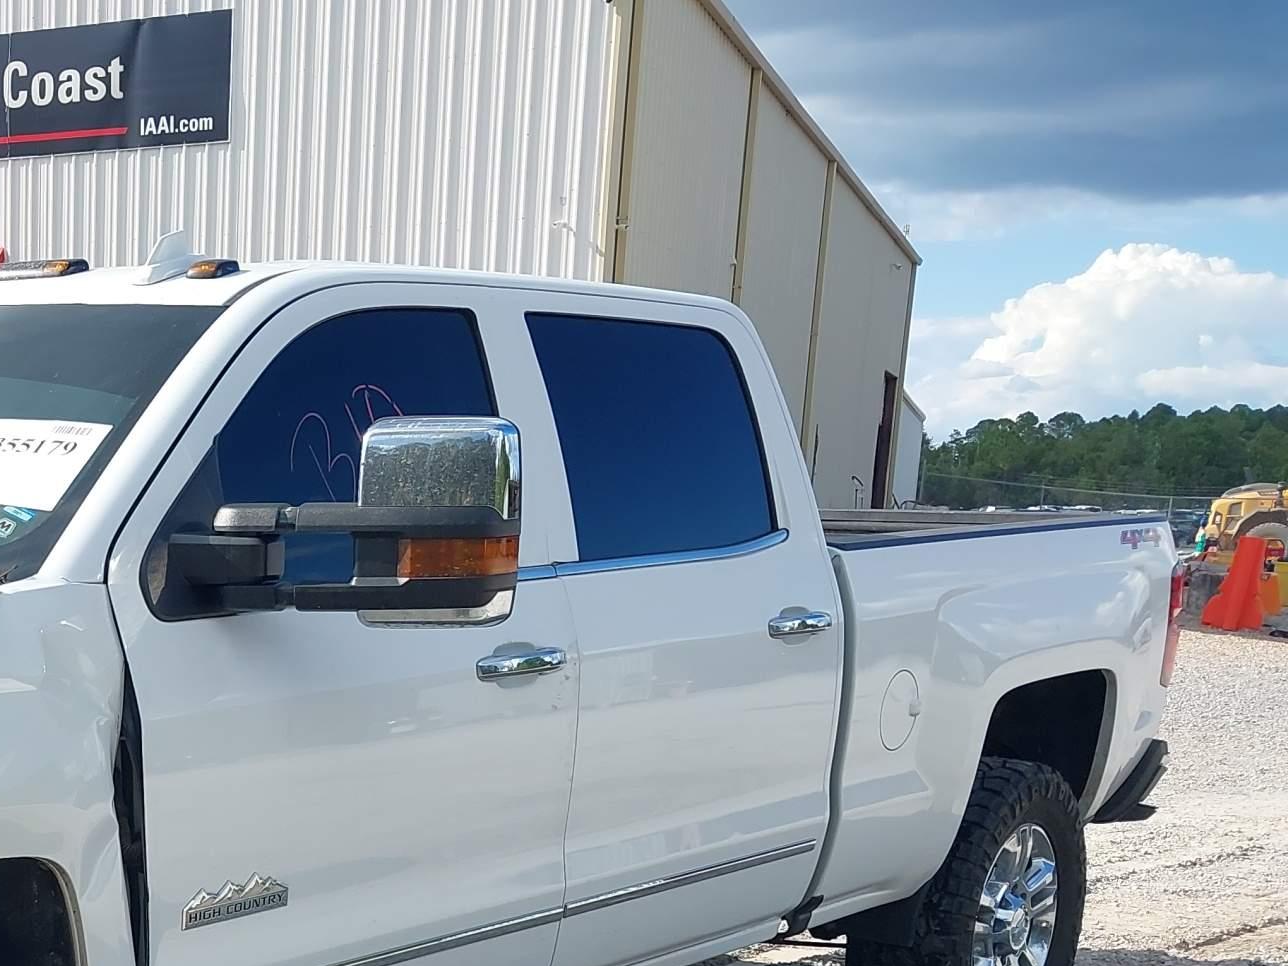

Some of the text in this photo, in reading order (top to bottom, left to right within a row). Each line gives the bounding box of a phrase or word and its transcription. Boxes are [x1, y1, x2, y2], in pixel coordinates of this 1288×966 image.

[3, 56, 125, 110] Coast
[139, 115, 213, 136] IAAI.com
[188, 892, 285, 924] HIGH COUNTRY
